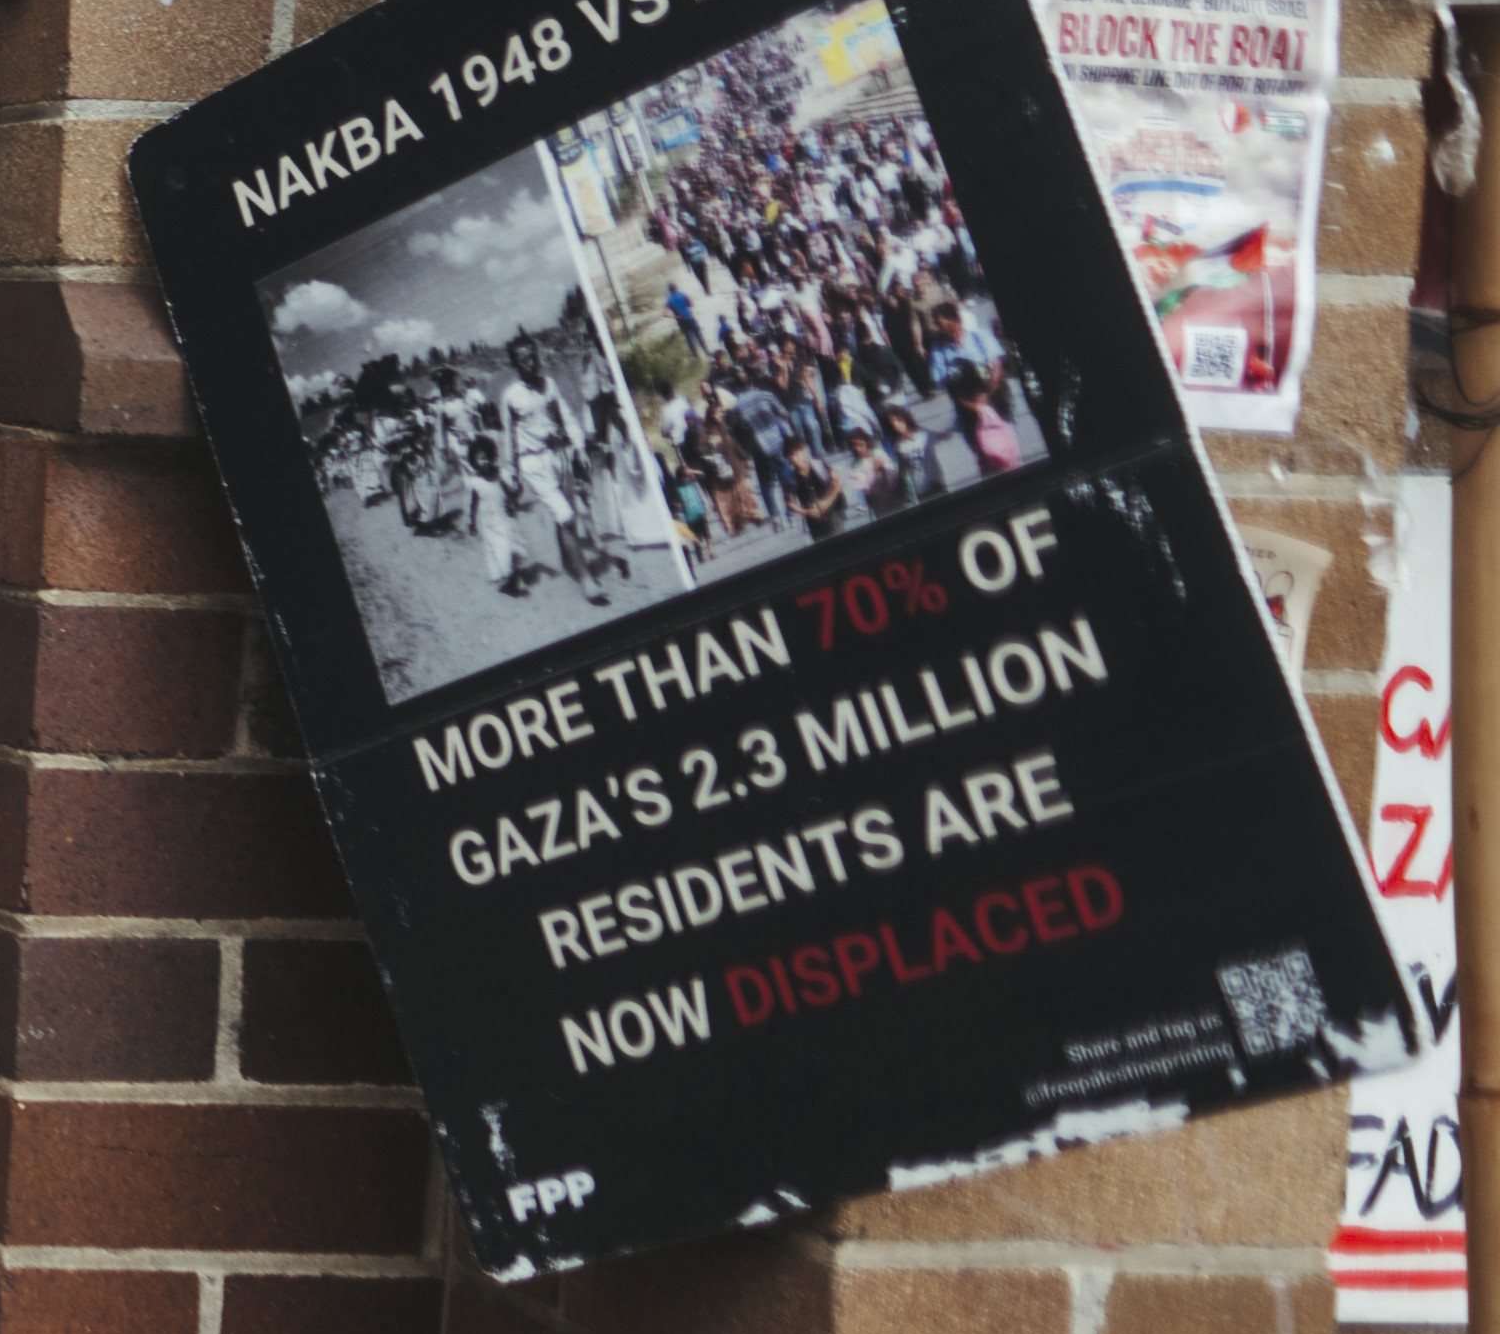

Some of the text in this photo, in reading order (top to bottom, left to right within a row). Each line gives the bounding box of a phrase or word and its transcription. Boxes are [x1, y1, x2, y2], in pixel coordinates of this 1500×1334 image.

[230, 97, 425, 229] NAKBA
[429, 17, 574, 123] 1948
[1058, 12, 1310, 72] BLOCK THE BOAT
[1079, 64, 1139, 86] SHIPPING
[1142, 68, 1171, 89] LINE
[1174, 71, 1198, 90] OUT
[1199, 73, 1217, 91] OF
[1218, 75, 1250, 95] PORT
[1253, 77, 1309, 98] BOTANY
[413, 507, 1060, 792] MORE THAN 70% OF
[447, 616, 1111, 887] GAZA'S 2.3 MILLION
[537, 752, 1075, 970] RESIDENTS ARE
[559, 865, 1126, 1076] NOW DISPLACED
[1066, 1015, 1223, 1063] Share and tag us
[506, 1170, 597, 1223] FPP
